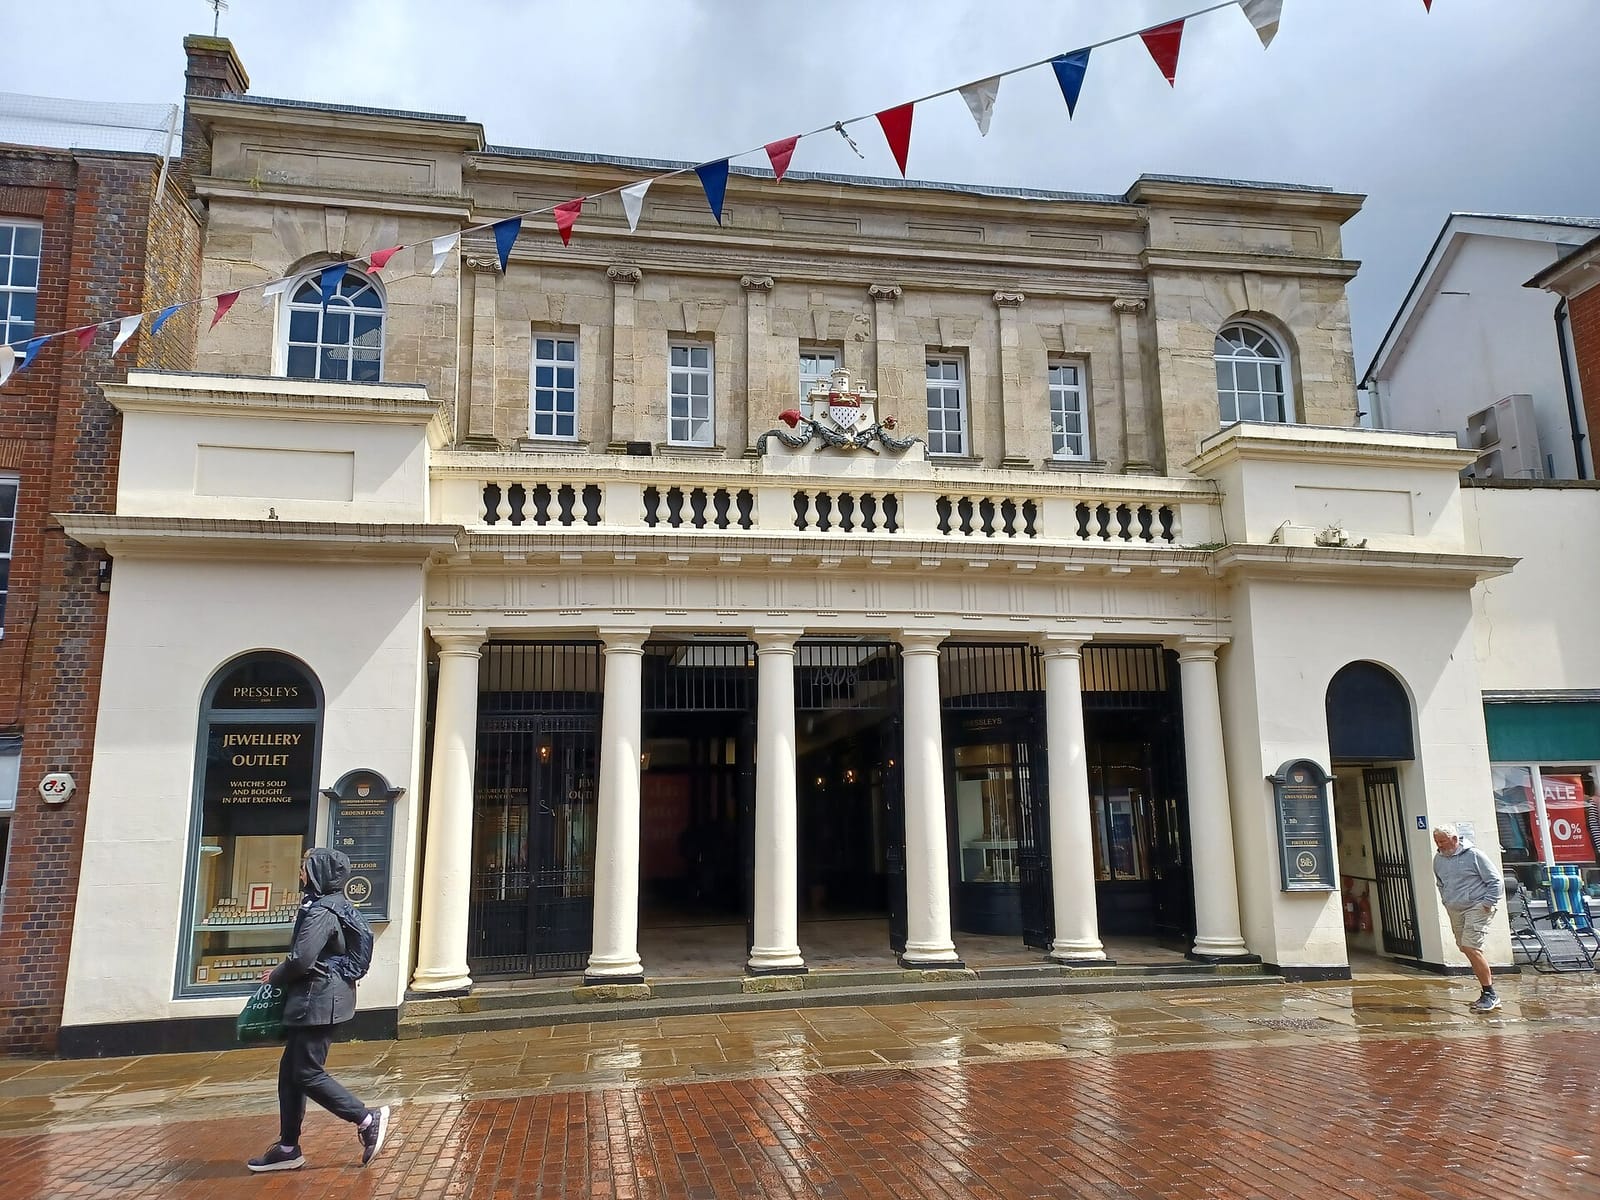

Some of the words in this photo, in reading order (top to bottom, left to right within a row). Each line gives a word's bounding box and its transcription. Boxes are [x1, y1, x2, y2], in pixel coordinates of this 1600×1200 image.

[233, 687, 299, 697] PRESSLEYS
[222, 734, 302, 748] JEWELLERY
[232, 754, 289, 767] OUTLET
[43, 780, 66, 793] G4S
[230, 780, 265, 788] WATCHES
[266, 780, 287, 788] SOLD
[251, 788, 284, 796] BOUGHT
[252, 796, 293, 804] EXCHANGE
